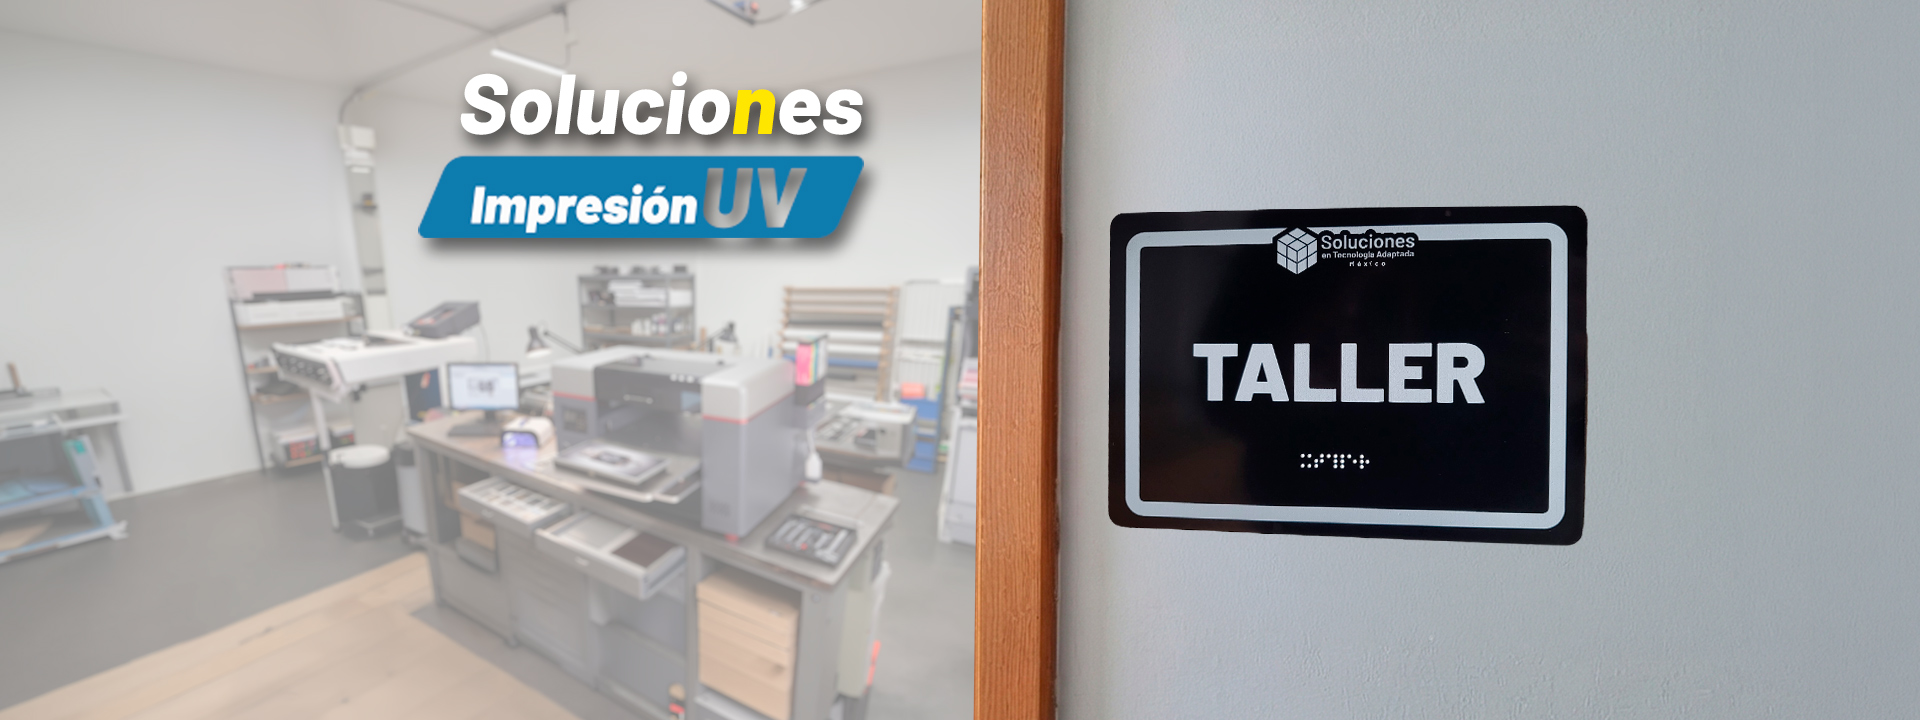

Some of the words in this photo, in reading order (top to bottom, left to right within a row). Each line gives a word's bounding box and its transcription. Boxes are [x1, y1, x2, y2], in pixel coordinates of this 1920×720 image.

[1321, 234, 1415, 250] Soluciones
[1376, 250, 1415, 260] Adaptada
[1193, 342, 1486, 404] TALLER
